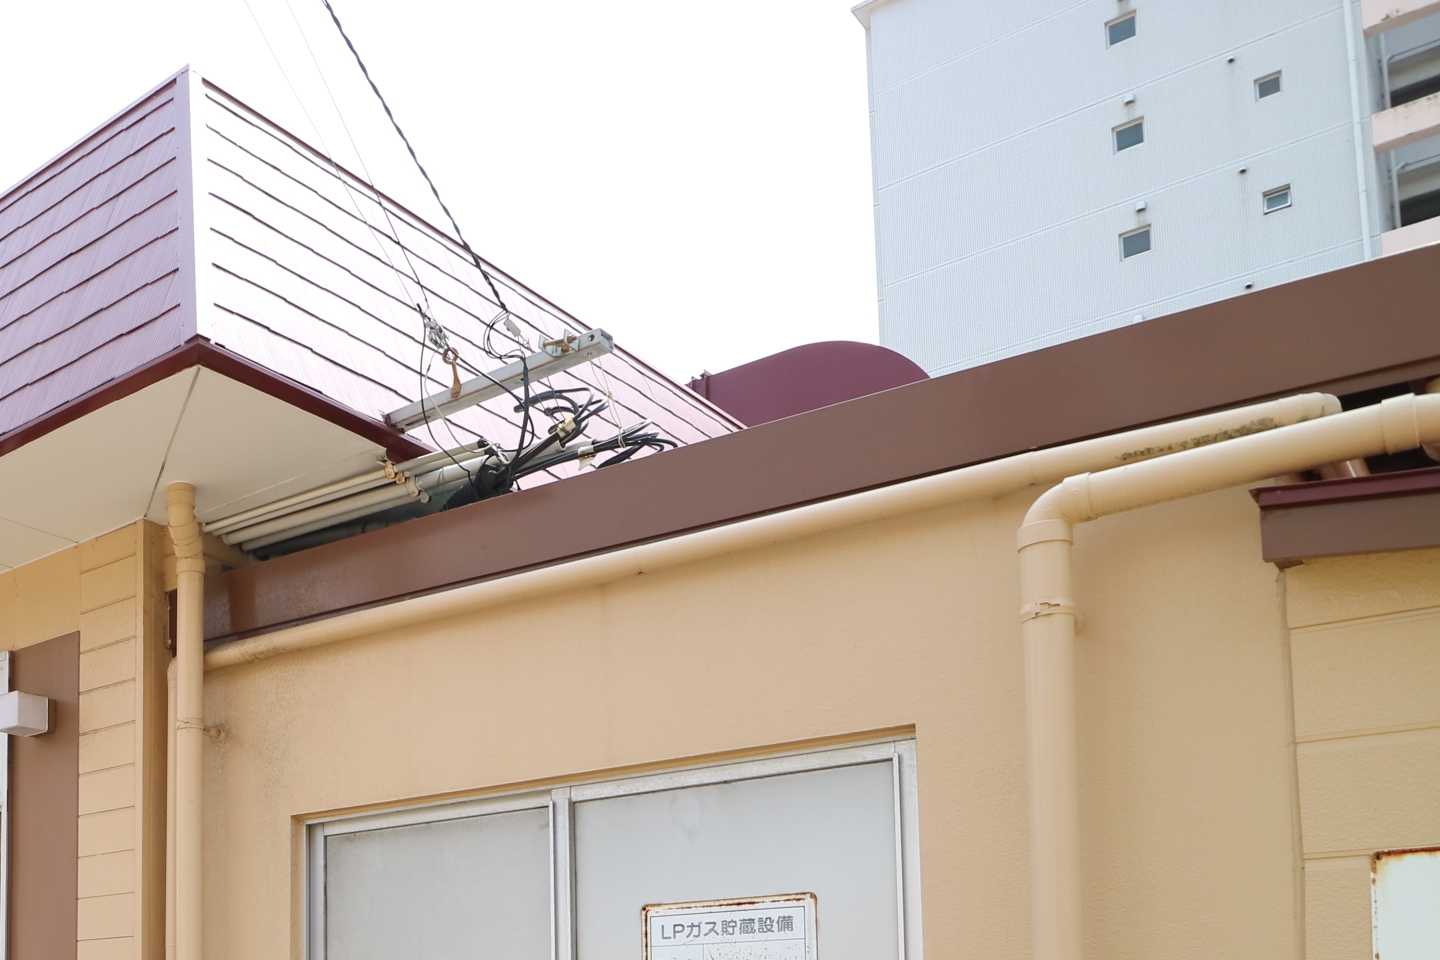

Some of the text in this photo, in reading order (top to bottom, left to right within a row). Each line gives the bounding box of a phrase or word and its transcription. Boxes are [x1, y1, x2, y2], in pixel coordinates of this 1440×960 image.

[660, 915, 794, 940] LPガス貯蔵設備
